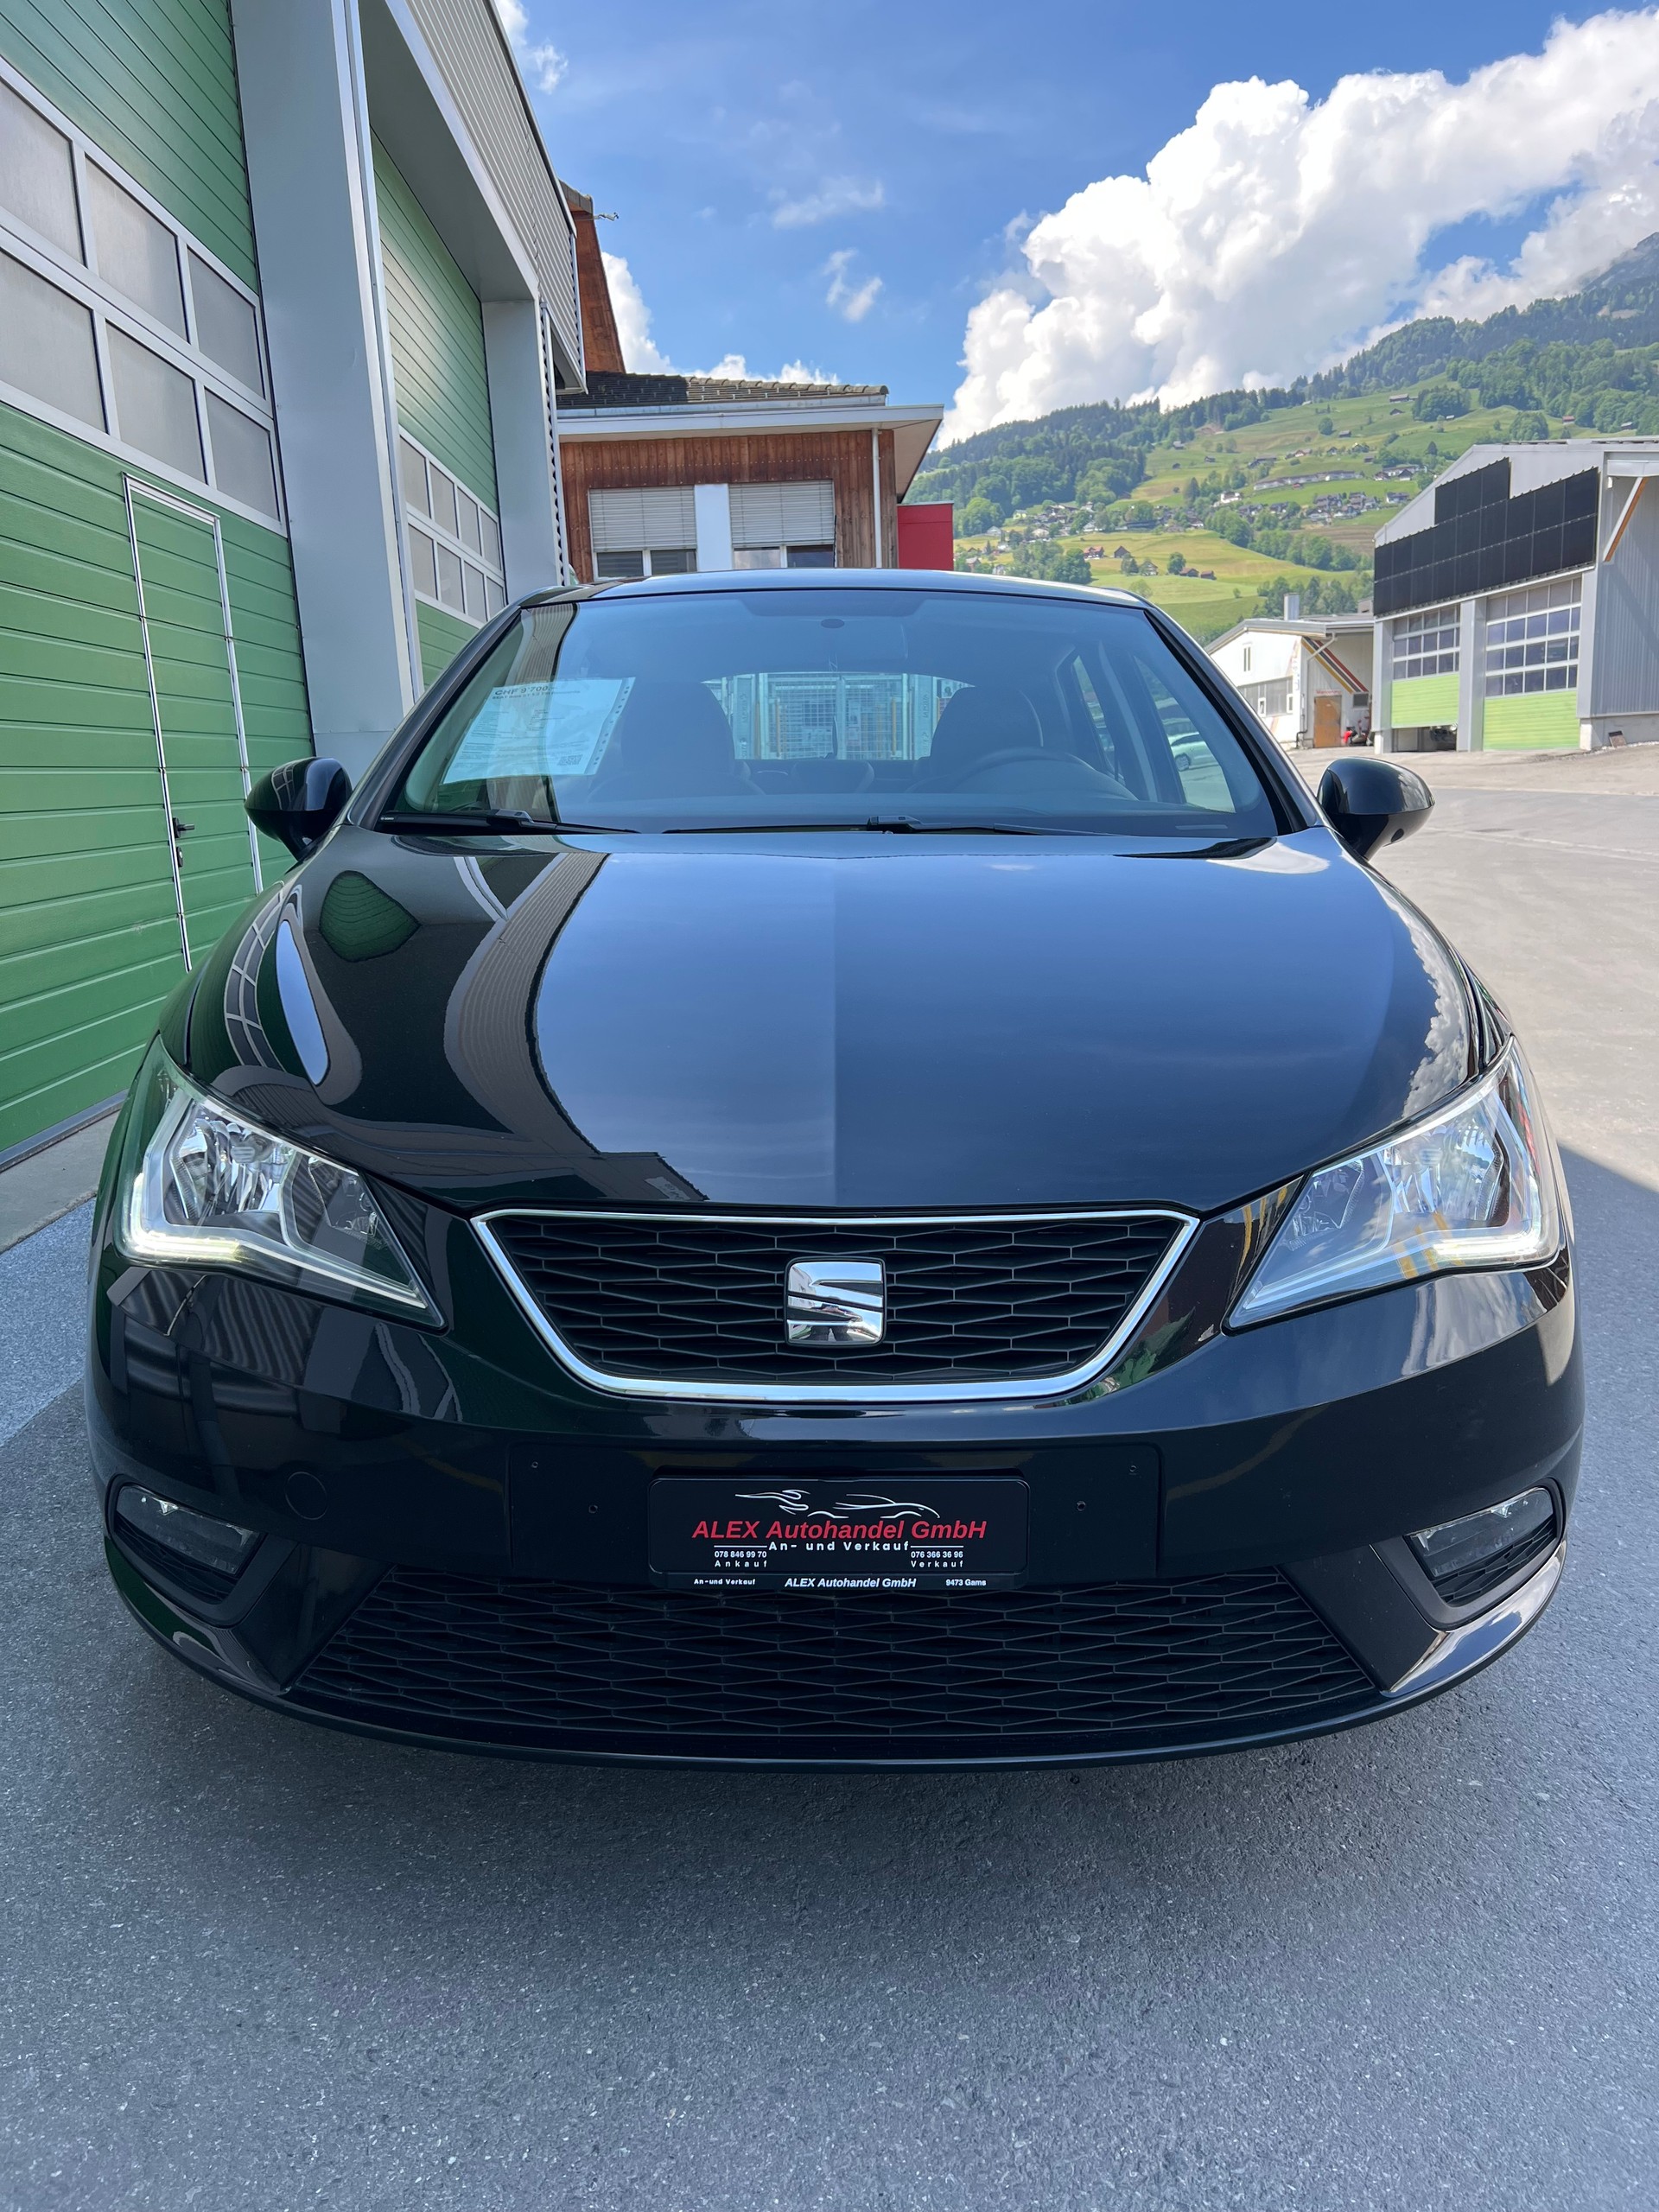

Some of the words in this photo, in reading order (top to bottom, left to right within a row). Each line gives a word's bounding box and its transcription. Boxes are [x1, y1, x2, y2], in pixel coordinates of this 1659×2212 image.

[692, 1521, 760, 1539] ALEX
[766, 1520, 905, 1539] Autohandel
[911, 1520, 987, 1539] GmbH
[768, 1541, 798, 1551] An-
[805, 1541, 836, 1551] und
[843, 1541, 909, 1551] Verkauf
[785, 1578, 816, 1587] ALEX
[817, 1578, 880, 1587] Autohandel
[881, 1578, 917, 1587] GmbH
